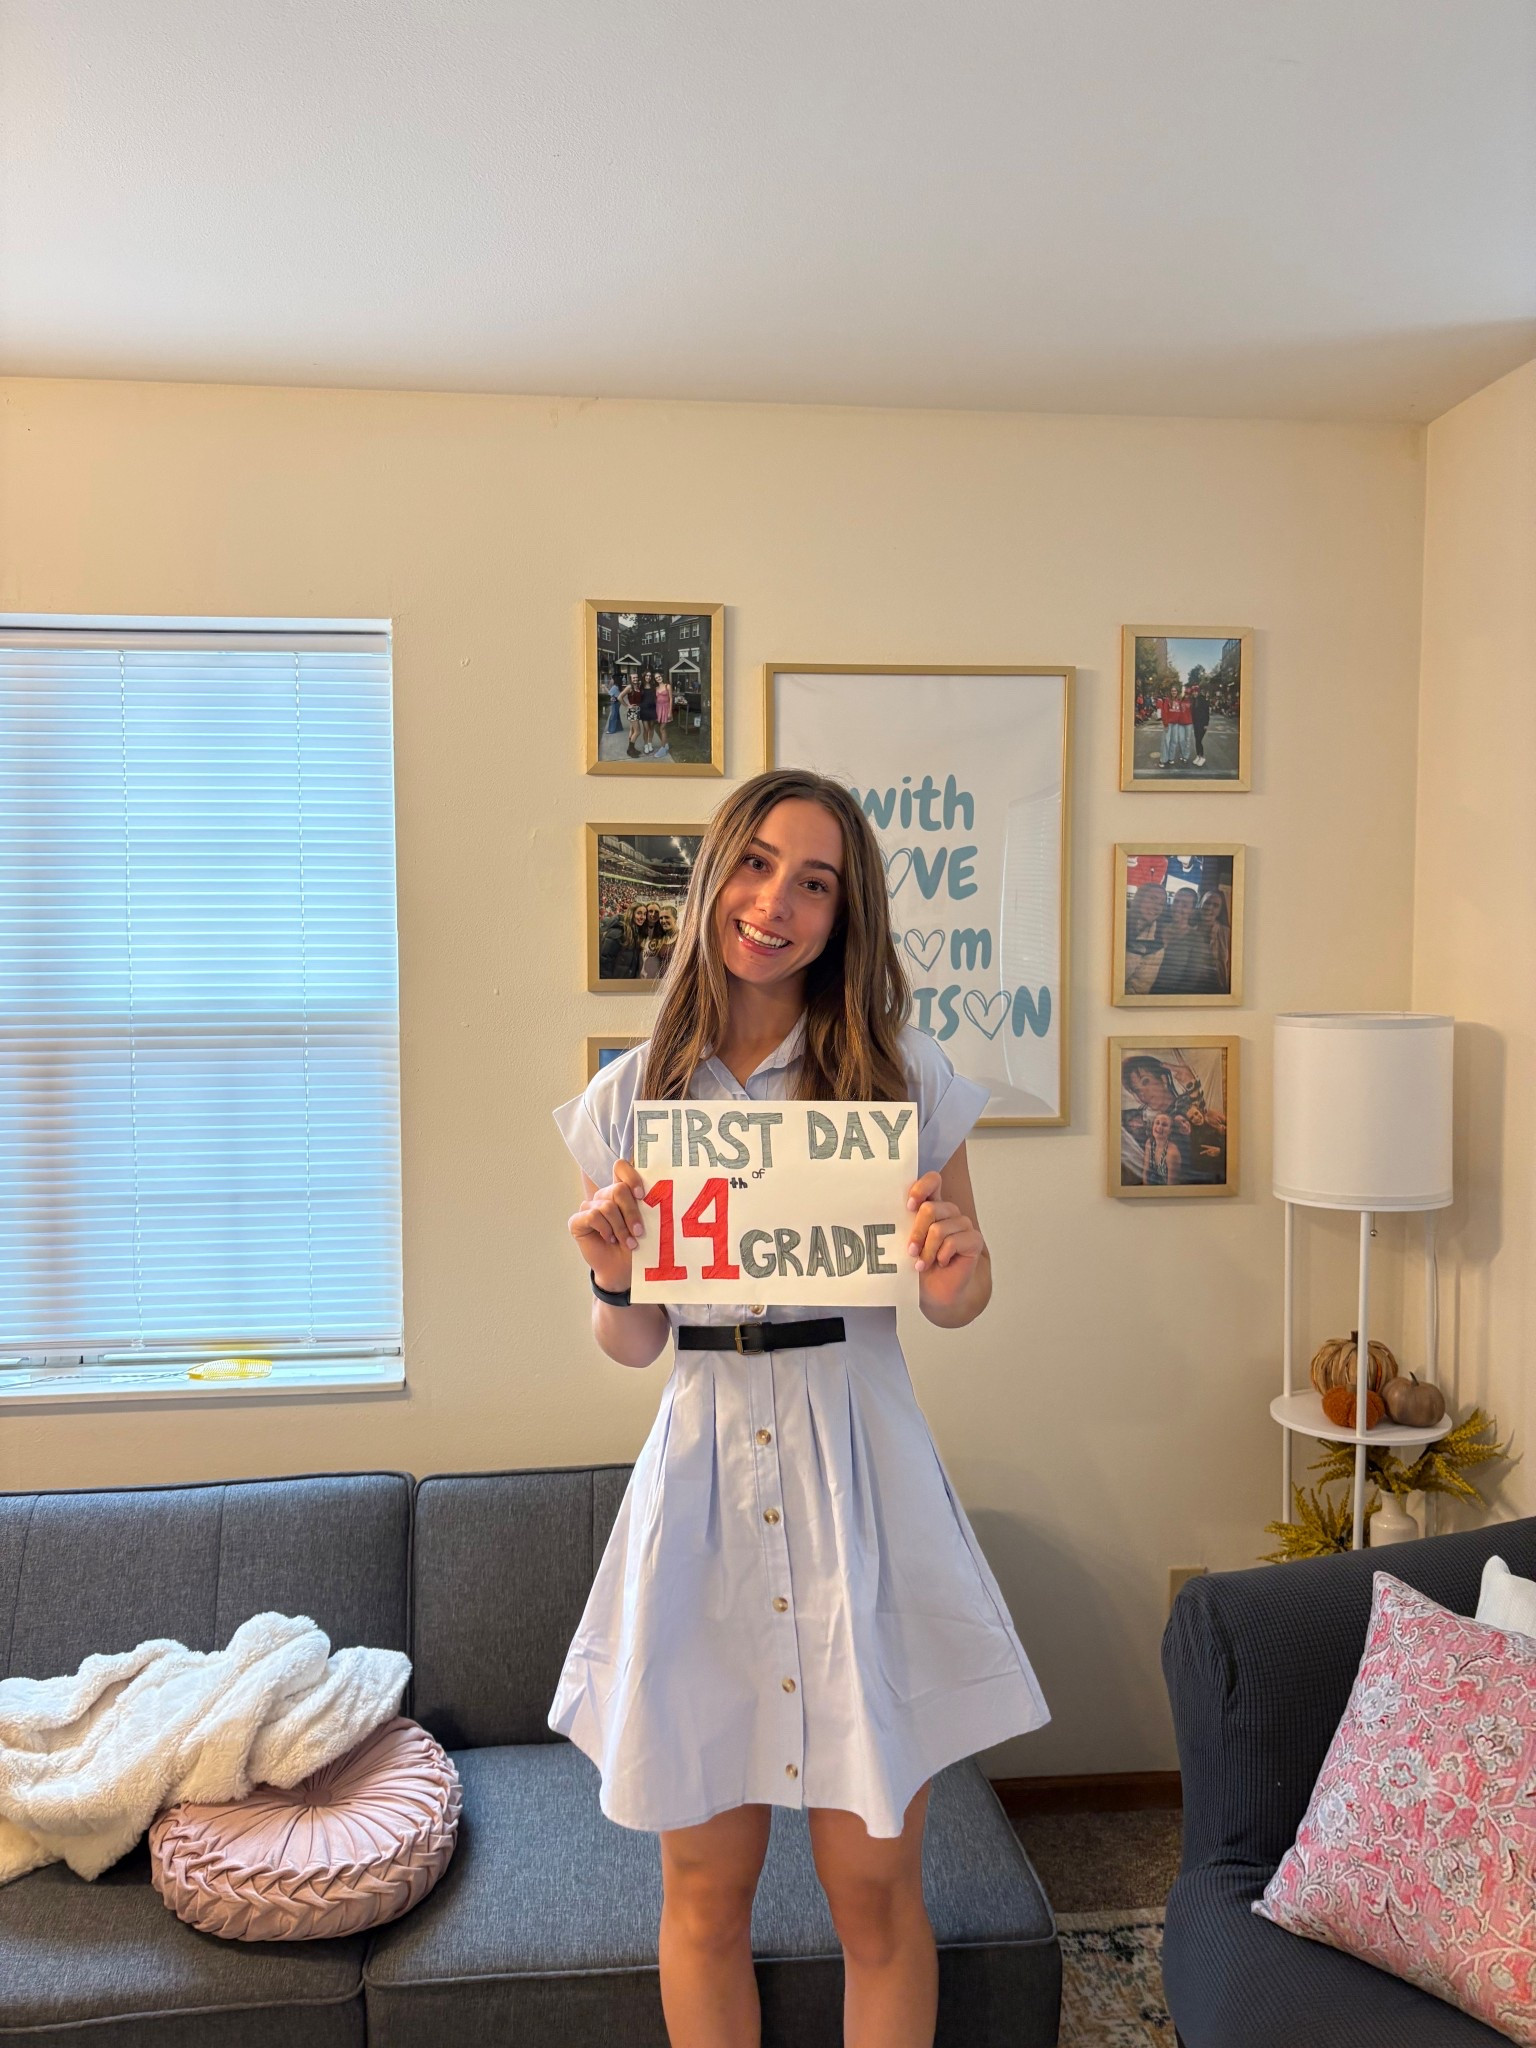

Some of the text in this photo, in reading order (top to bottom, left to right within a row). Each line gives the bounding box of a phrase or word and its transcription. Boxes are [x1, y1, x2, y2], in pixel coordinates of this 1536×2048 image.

[849, 774, 975, 831] with
[634, 1109, 913, 1169] FIRST DAY
[751, 1168, 766, 1179] of
[739, 1223, 898, 1279] GRADE
